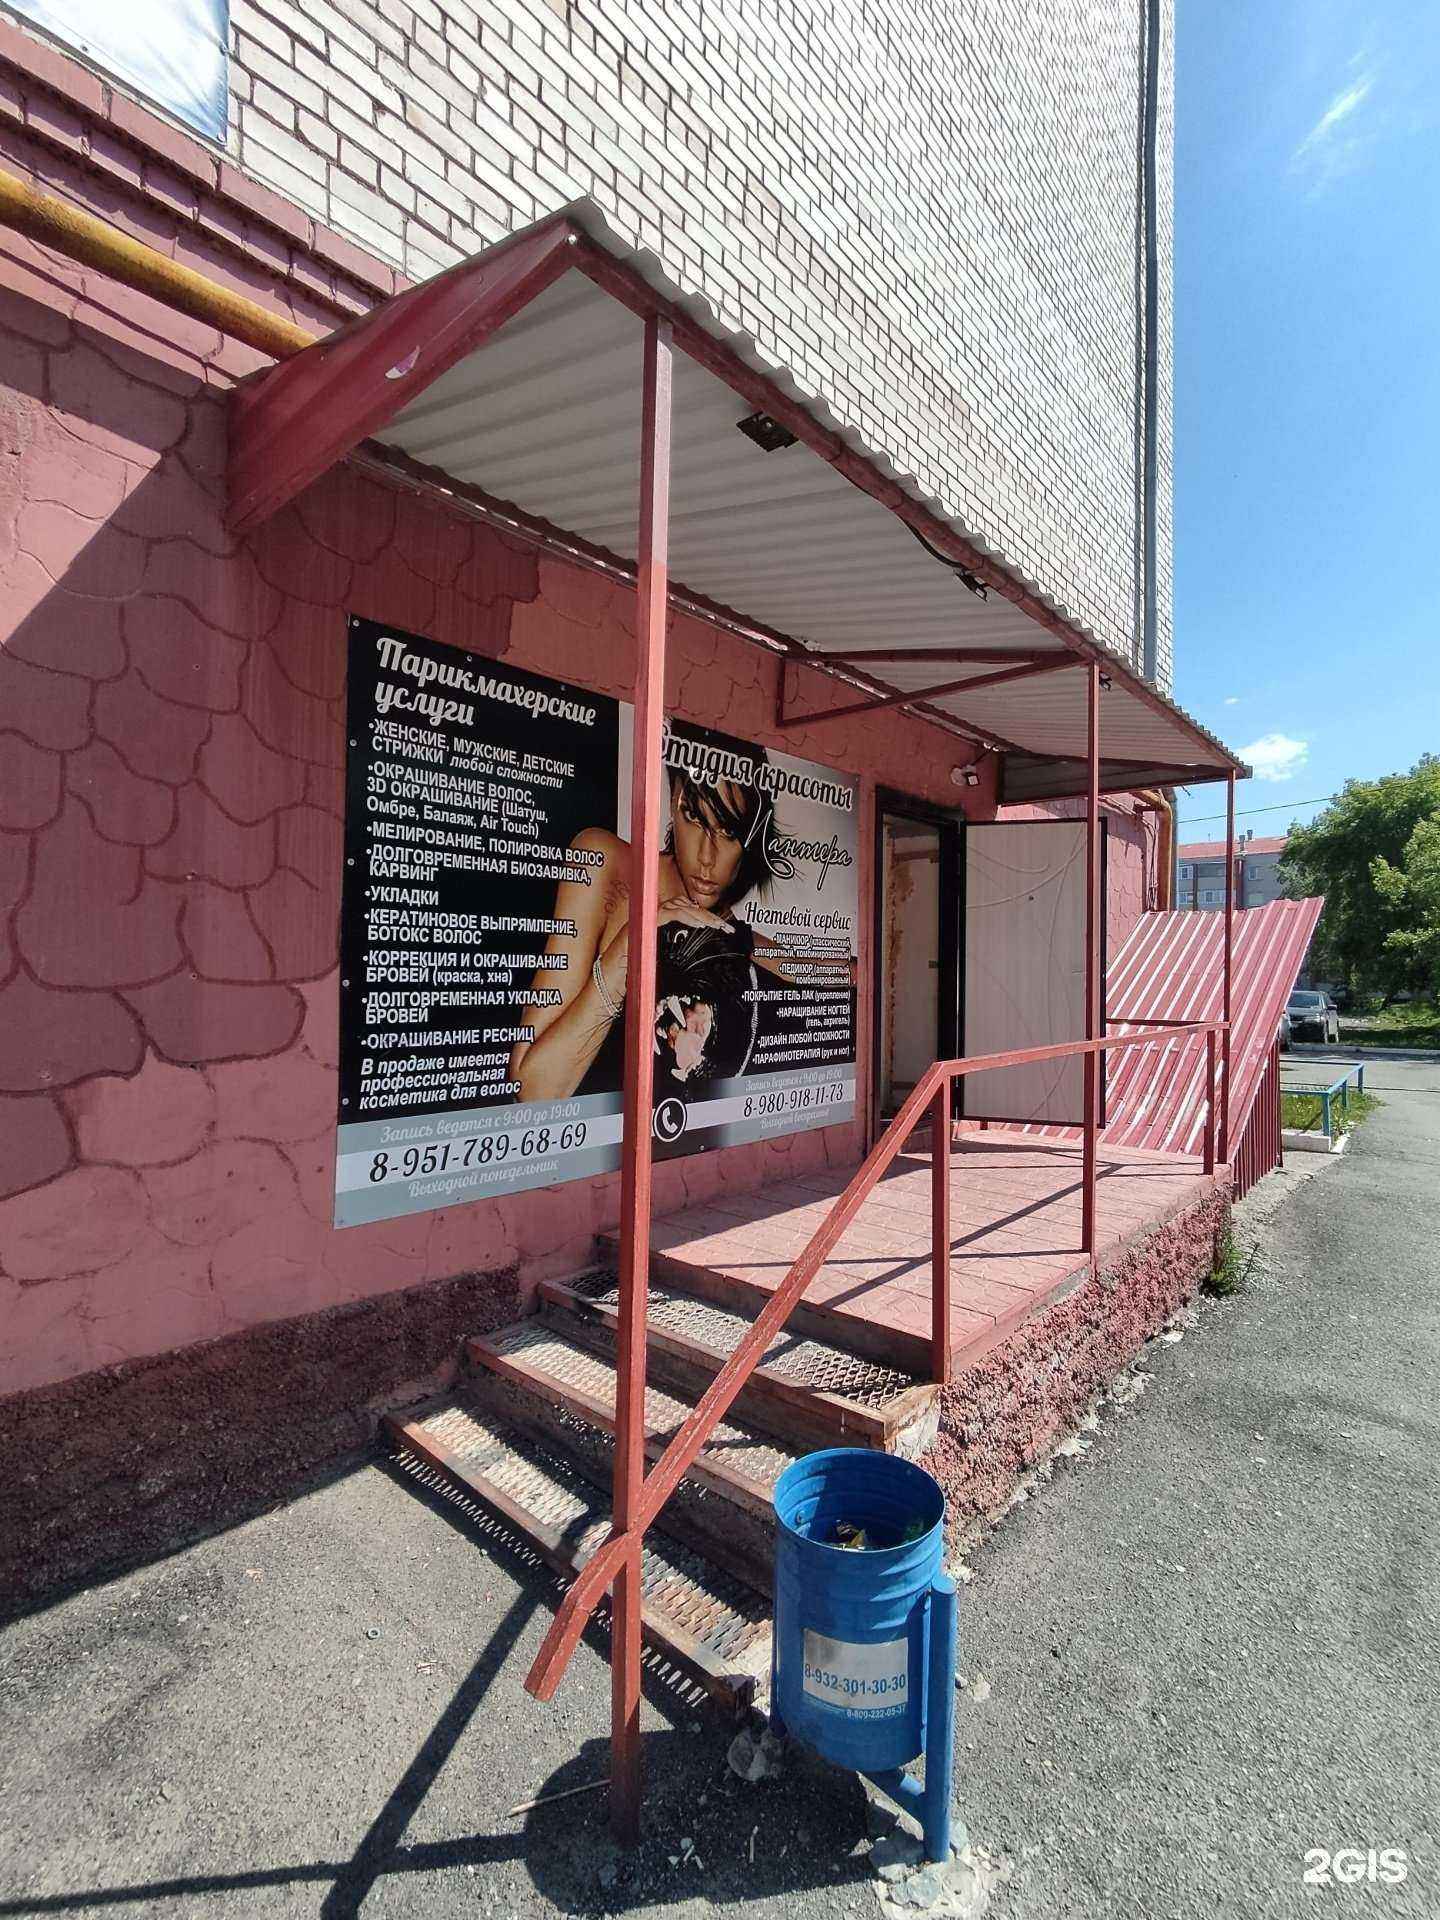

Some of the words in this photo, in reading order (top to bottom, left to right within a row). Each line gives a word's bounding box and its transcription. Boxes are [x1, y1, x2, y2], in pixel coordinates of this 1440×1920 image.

[376, 637, 597, 726] Парикмахерские
[374, 681, 474, 726] услуги
[372, 735, 444, 764] СТРИЖКИ
[450, 754, 494, 775] любой
[496, 765, 563, 789] сложности
[374, 718, 450, 751] ЖЕНСКИЕ,
[453, 737, 520, 766] МУЖСКИЕ,
[523, 753, 575, 778] ДЕТСКИЕ
[374, 760, 485, 796] ОКРАШИВАНИЕ
[488, 783, 536, 807] ВОЛОС,
[760, 763, 852, 811] красоты
[367, 776, 387, 794] 3D
[391, 781, 499, 813] ОКРАШИВАНИЕ
[501, 801, 549, 823] (Шатуш,
[366, 796, 419, 820] Омбре,
[423, 805, 477, 830] Балаяж,
[480, 815, 499, 831] Air
[501, 817, 539, 839] Touch)
[372, 821, 486, 853] МЕЛИРОВАНИЕ,
[489, 837, 563, 862] ПОЛИРОВКА
[565, 849, 604, 867] ВОЛОС
[369, 860, 439, 882] КАРВИНГ
[370, 843, 507, 875] ДОЛГОВРЕМЕННАЯ
[510, 860, 591, 886] БИОЗАВИВКА,
[371, 885, 439, 907] УКЛАДКИ
[370, 908, 478, 930] КЕРАТИНОВОЕ
[480, 915, 577, 937] ВЫПРЯМЛЕНИЕ,
[744, 901, 812, 928] Ногтевой
[814, 909, 852, 933] сервис
[367, 925, 429, 943] БОТОКС
[433, 928, 482, 945] ВОЛОС
[368, 950, 457, 969] КОРРЕКЦИЯ
[461, 953, 470, 967] И
[473, 953, 568, 969] ОКРАШИВАНИЕ
[366, 964, 429, 983] БРОВЕЙ
[432, 969, 484, 986] (краска,
[487, 969, 513, 986] хна)
[367, 991, 505, 1011] ДОЛГОВРЕМЕННАЯ
[508, 989, 562, 1007] УКЛАДКА
[744, 990, 782, 1002] ПОКРЫТИЕ
[783, 990, 801, 1001] ГЕЛЬ
[801, 990, 815, 1000] ЛАК
[778, 1005, 827, 1018] НАРАЩИВАНИЕ
[828, 1003, 851, 1016] НОГТЕЙ
[365, 1004, 428, 1025] БРОВЕЙ
[367, 1028, 480, 1049] ОКРАШИВАНИЕ
[483, 1027, 534, 1044] РЕСНИЦ
[760, 1032, 787, 1048] ДИЗАЙН
[788, 1030, 813, 1044] ЛЮБОЙ
[813, 1029, 850, 1042] СЛОЖНОСТИ
[361, 1058, 373, 1075] В
[377, 1055, 445, 1077] продаже
[448, 1052, 511, 1069] имеется
[359, 1088, 448, 1110] косметика
[450, 1083, 477, 1101] для
[480, 1081, 521, 1096] волос
[360, 1067, 506, 1096] профессиональная
[743, 1082, 843, 1118] 8-980-918-11-73
[380, 1122, 433, 1144] Запись
[436, 1114, 492, 1138] ведется
[503, 1107, 532, 1127] 9:00
[550, 1102, 581, 1121] 19:00
[369, 1122, 587, 1183] 8-951-789-68-69
[408, 1172, 478, 1198] Выходной
[804, 1663, 907, 1695] 8-932-301-30-30
